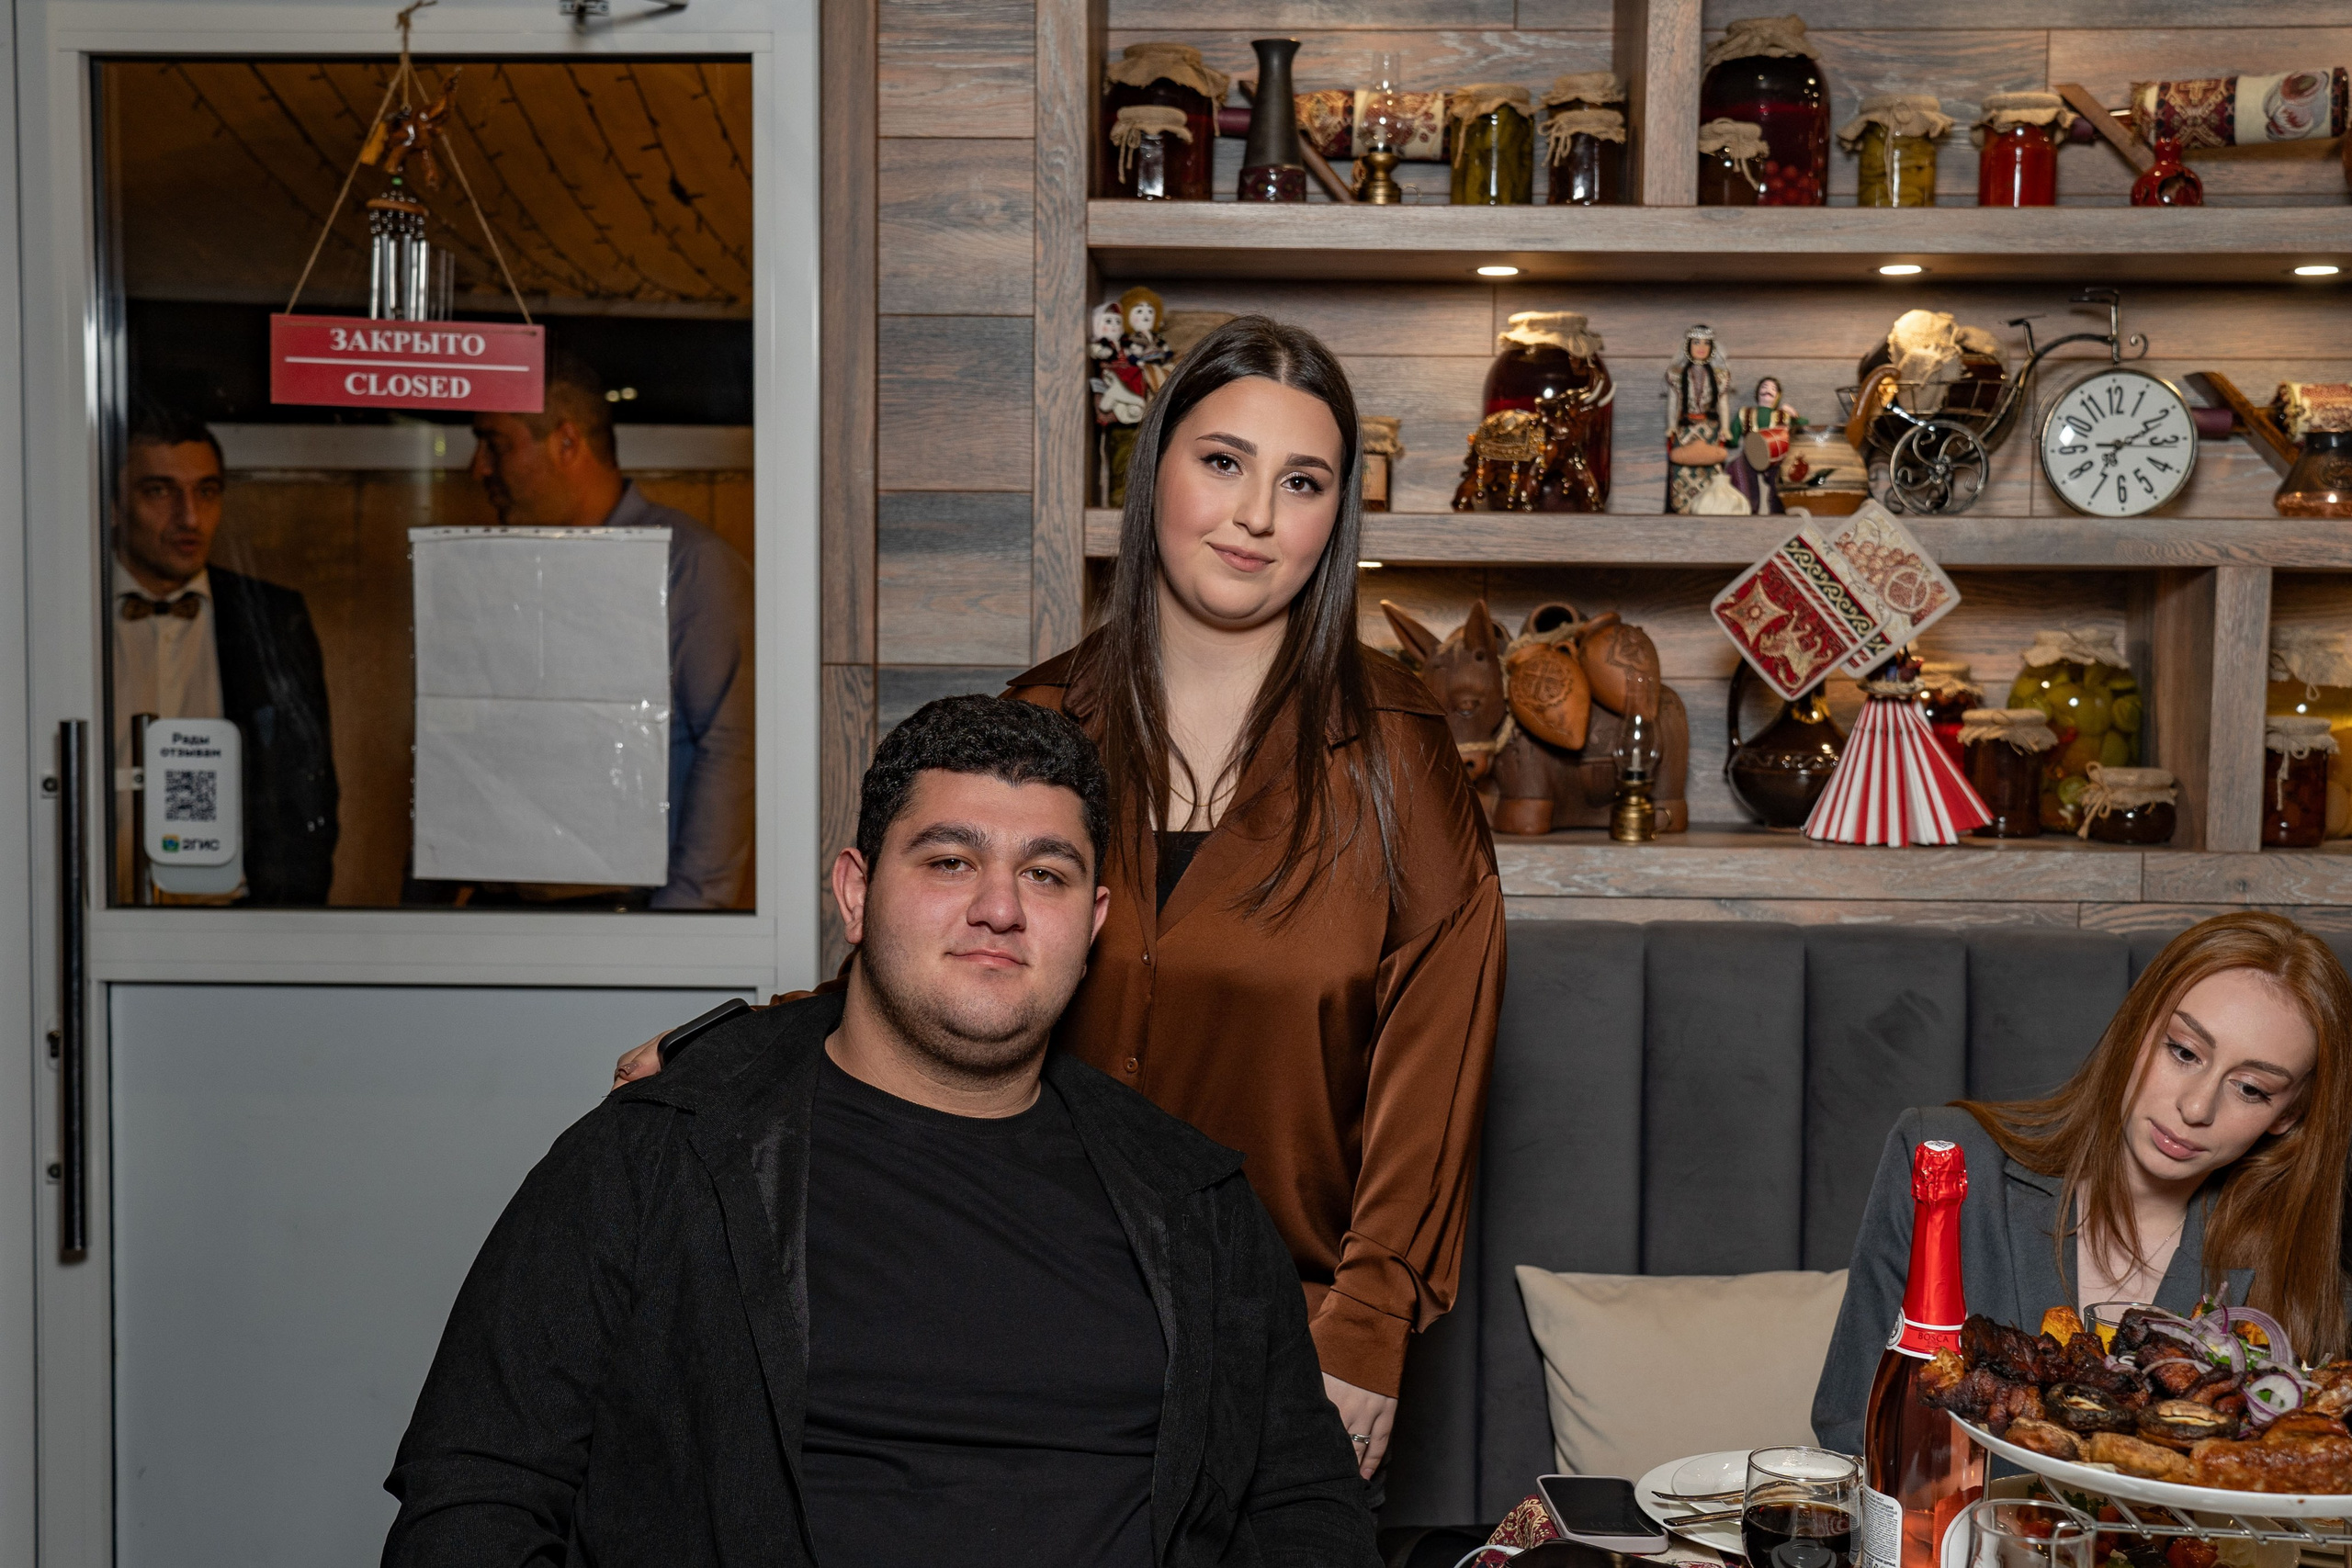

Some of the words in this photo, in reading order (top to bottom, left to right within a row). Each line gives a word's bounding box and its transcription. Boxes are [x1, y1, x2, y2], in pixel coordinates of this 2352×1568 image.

[329, 327, 486, 356] ЗАКРЫТО
[344, 371, 472, 399] CLOSED
[2080, 394, 2106, 423] 11
[2106, 386, 2124, 415] 12
[2131, 390, 2146, 418] 1
[2142, 409, 2170, 433] 2
[2058, 444, 2088, 455] 9
[2149, 434, 2179, 446] 3
[2068, 460, 2094, 480] 8
[2146, 457, 2174, 473] 4
[2090, 472, 2109, 500] 7
[2117, 475, 2127, 504] 6
[2132, 468, 2154, 494] 5
[172, 732, 210, 746] Рады
[182, 837, 220, 852] 2ГИС
[1917, 1332, 1950, 1343] BOSCA
